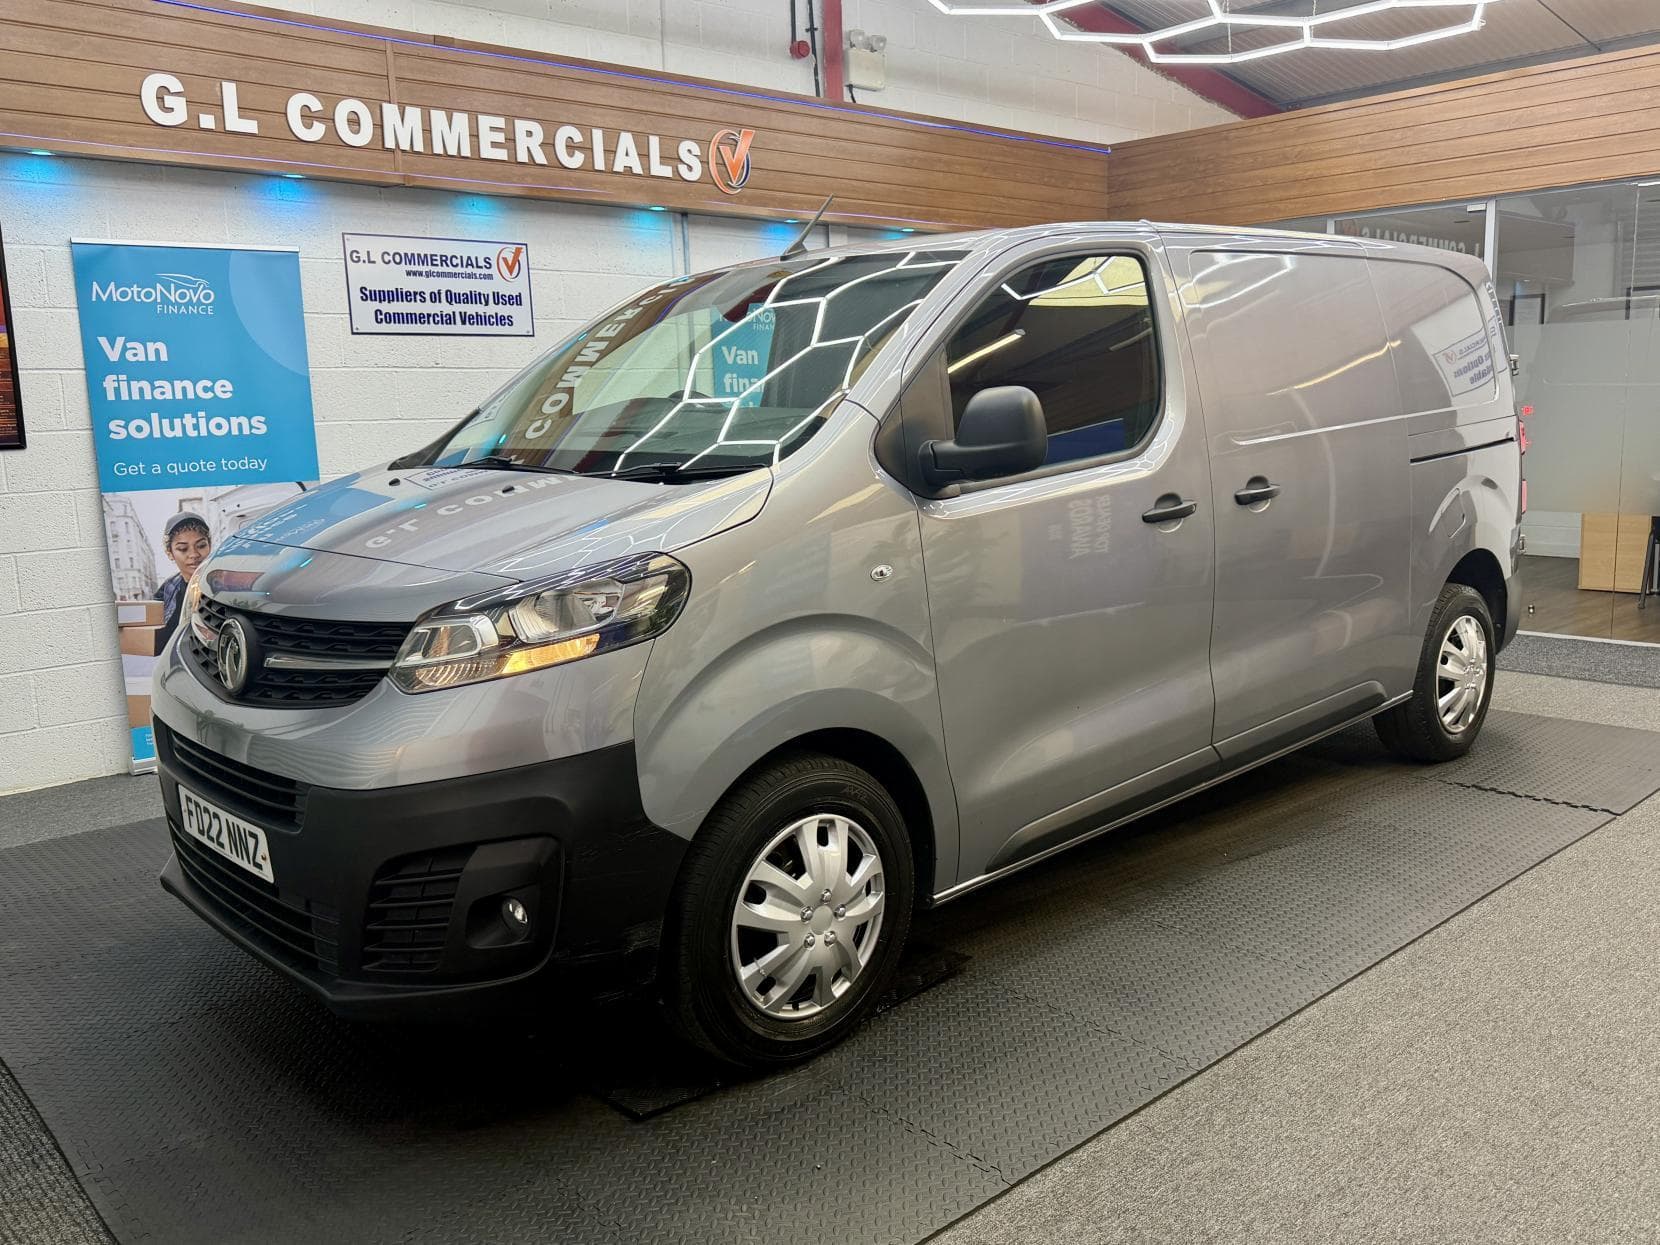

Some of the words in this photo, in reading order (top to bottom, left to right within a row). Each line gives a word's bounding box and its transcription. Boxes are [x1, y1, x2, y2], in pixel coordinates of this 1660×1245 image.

[140, 73, 259, 134] G.L
[286, 92, 702, 182] COMMERCIALS
[349, 250, 376, 264] G.L
[381, 252, 492, 269] COMMERCIALS
[405, 269, 494, 280] www.glcommercials.com
[91, 279, 215, 305] MotoNovo
[359, 286, 426, 304] Suppliers
[429, 289, 442, 303] of
[445, 289, 490, 307] Quality
[492, 291, 523, 306] Used
[156, 304, 214, 315] FINANCE
[374, 308, 457, 326] Commercial
[459, 311, 514, 326] Vehicles
[97, 336, 168, 362] Van
[721, 346, 759, 365] Van
[103, 374, 233, 401] finance
[108, 411, 268, 440] solutions
[113, 460, 146, 476] Get
[151, 463, 161, 474] a
[167, 459, 216, 475] quote
[221, 455, 267, 471] today
[185, 794, 226, 850] FD22
[226, 818, 263, 871] NNZ
